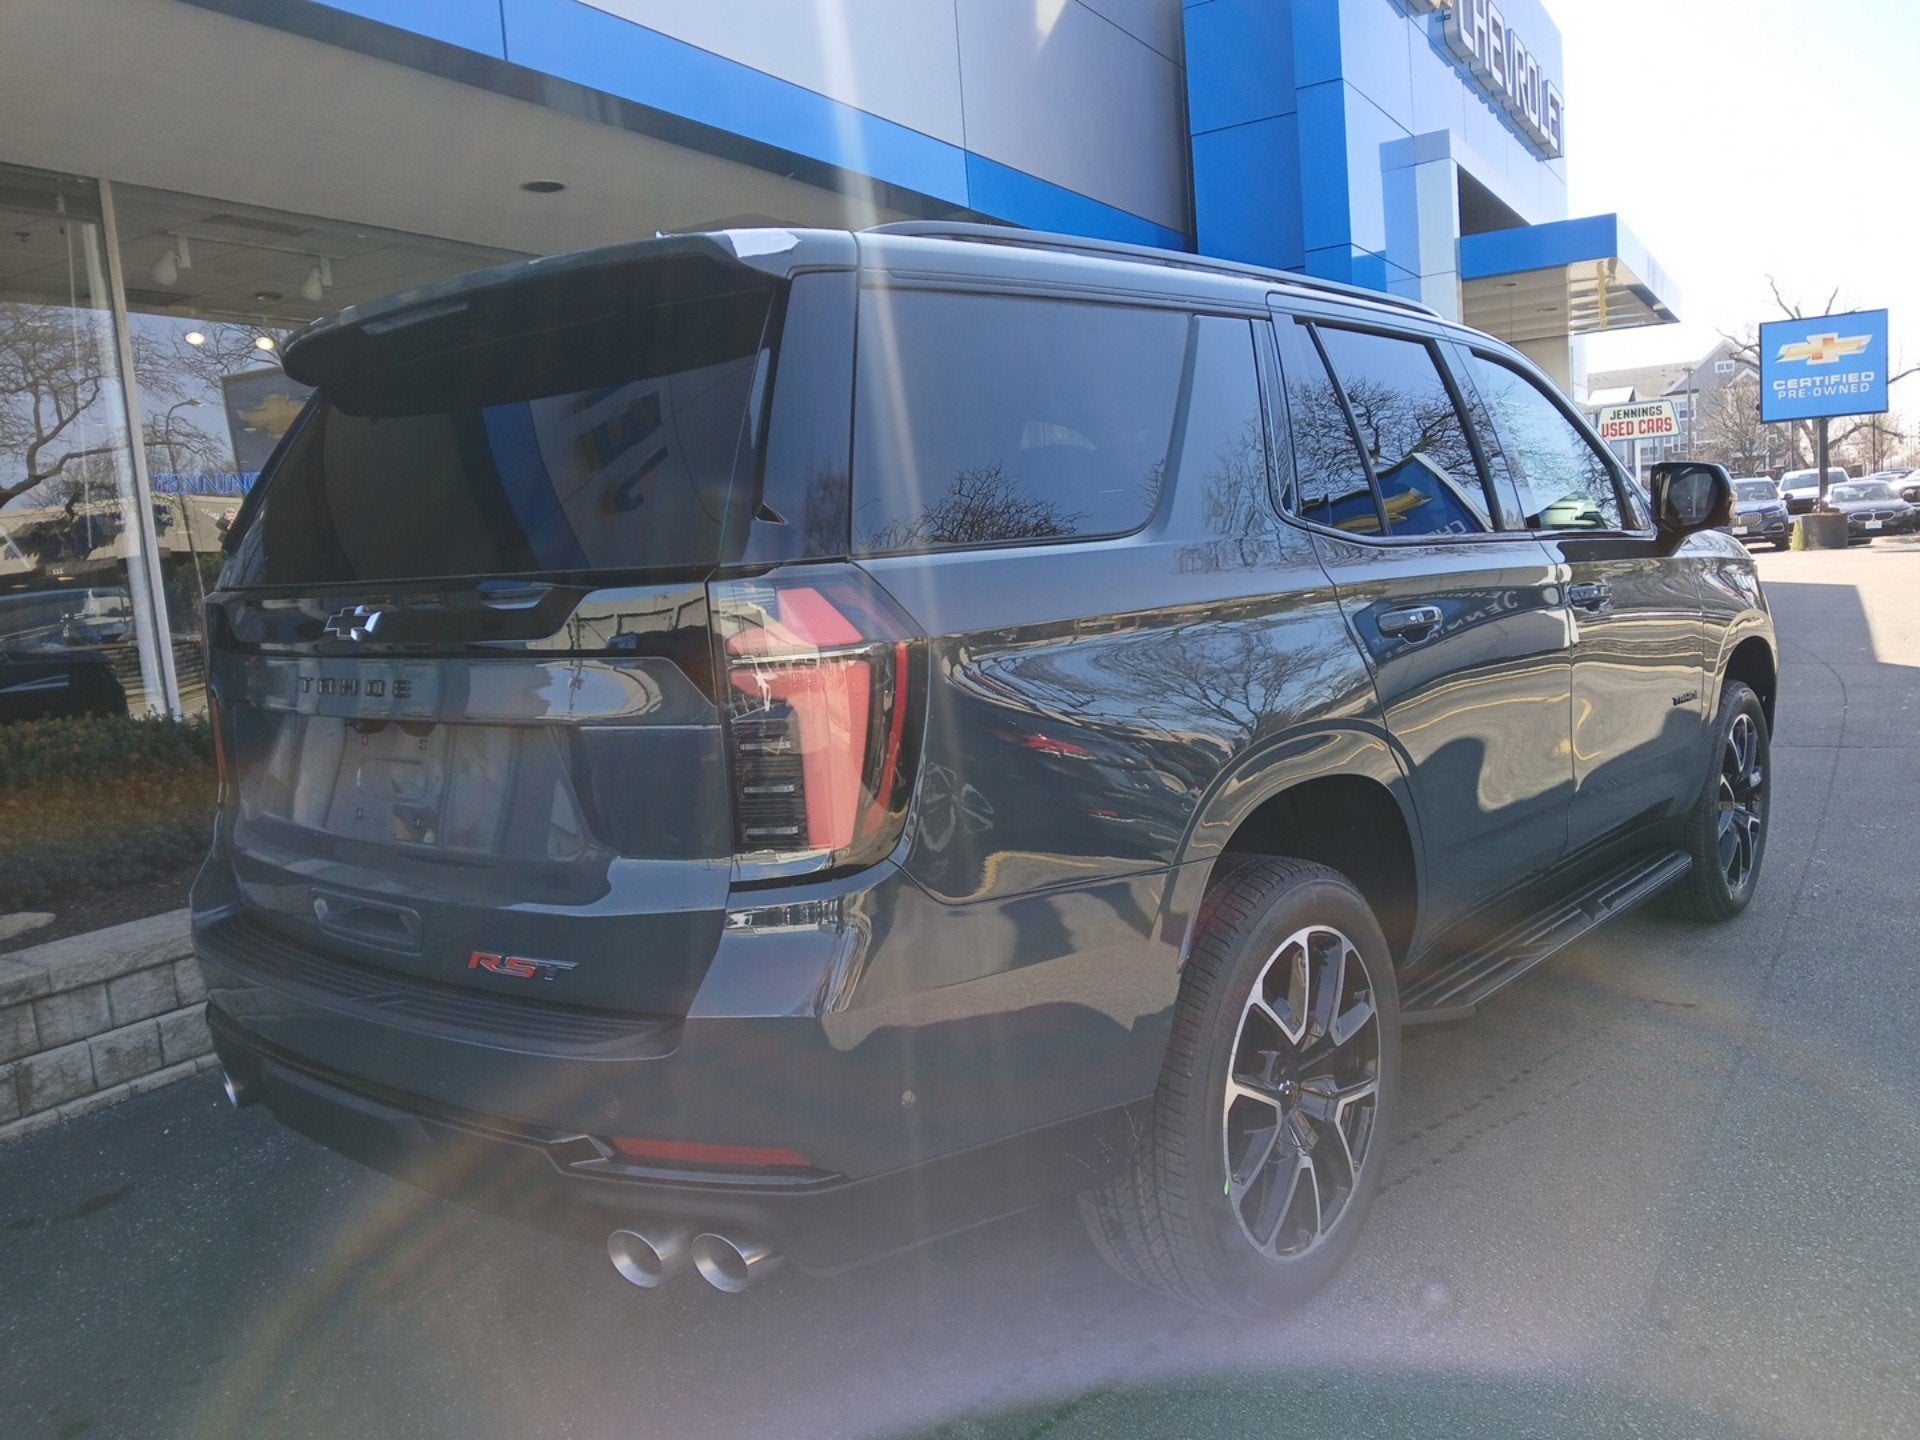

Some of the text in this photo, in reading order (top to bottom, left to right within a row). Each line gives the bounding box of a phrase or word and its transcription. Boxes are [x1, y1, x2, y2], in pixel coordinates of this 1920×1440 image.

[1773, 371, 1875, 391] CERTIFIED
[1778, 382, 1870, 400] PRE-OWNED
[1610, 404, 1663, 421] JENNINGS
[1601, 416, 1673, 438] USED CARS
[299, 677, 412, 698] TAHOE
[467, 951, 578, 980] RST
